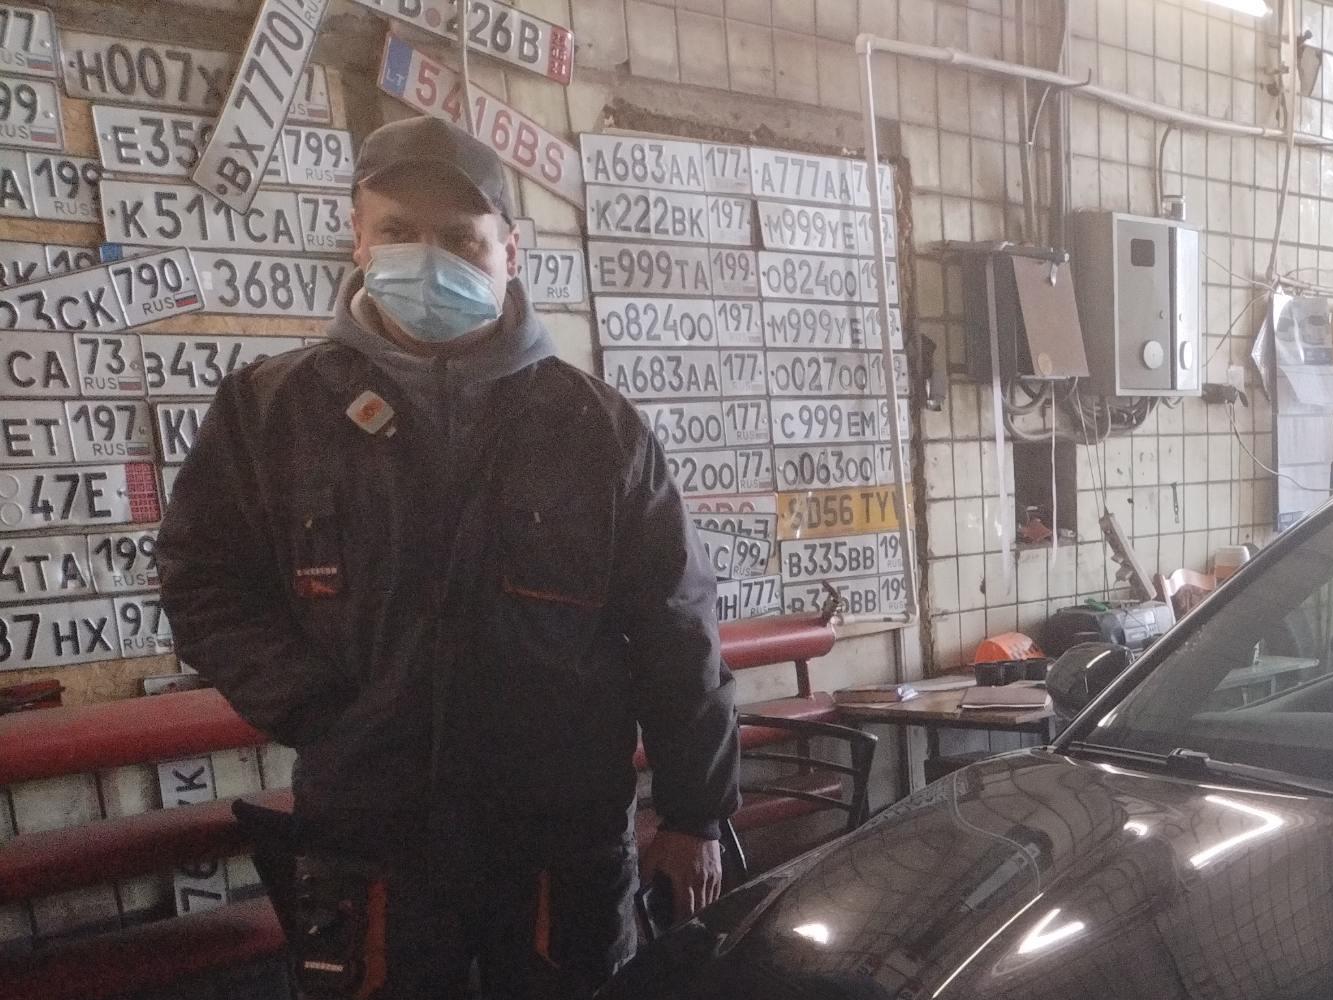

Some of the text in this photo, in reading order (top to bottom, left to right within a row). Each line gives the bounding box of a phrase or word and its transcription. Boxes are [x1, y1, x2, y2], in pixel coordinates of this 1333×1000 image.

[284, 128, 342, 168] 799
[705, 146, 741, 178] 177
[305, 167, 334, 182] RUS
[303, 197, 341, 233] 73
[306, 233, 336, 247] RUS
[528, 253, 575, 285] 797
[713, 251, 750, 281] 199
[112, 257, 184, 305] 790
[546, 286, 570, 299] RUS
[142, 296, 175, 315] RUS
[718, 302, 754, 332] 197
[79, 337, 126, 375] 73
[722, 353, 759, 381] 177
[84, 376, 118, 391] RUS
[73, 404, 137, 442] 197
[726, 402, 762, 431] 177
[92, 443, 126, 457] RUS
[739, 450, 764, 479] 77
[737, 540, 761, 568] 99
[113, 573, 147, 588] RUS
[742, 579, 776, 608] 777
[120, 600, 162, 637] 97
[123, 637, 156, 650] RUS
